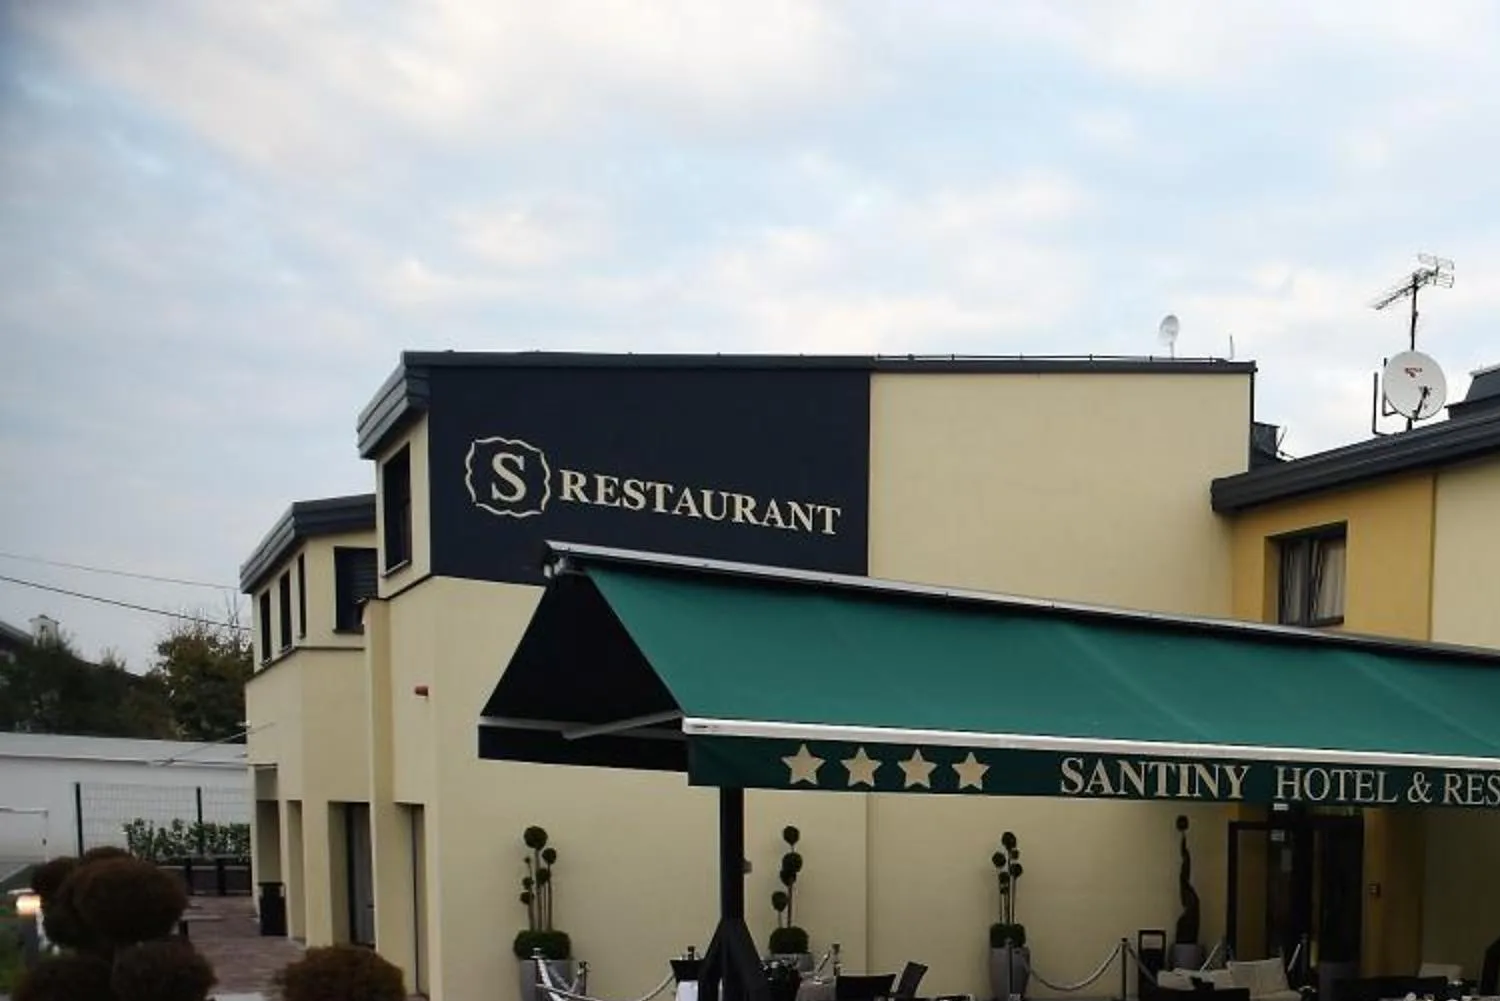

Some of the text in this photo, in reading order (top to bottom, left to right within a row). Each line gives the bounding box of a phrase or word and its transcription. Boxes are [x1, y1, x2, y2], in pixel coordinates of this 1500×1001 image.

[491, 452, 842, 535] S RESTAURANT
[1060, 757, 1251, 799] SANTINY
[1275, 766, 1397, 803] HOTEL
[1407, 771, 1433, 803] &
